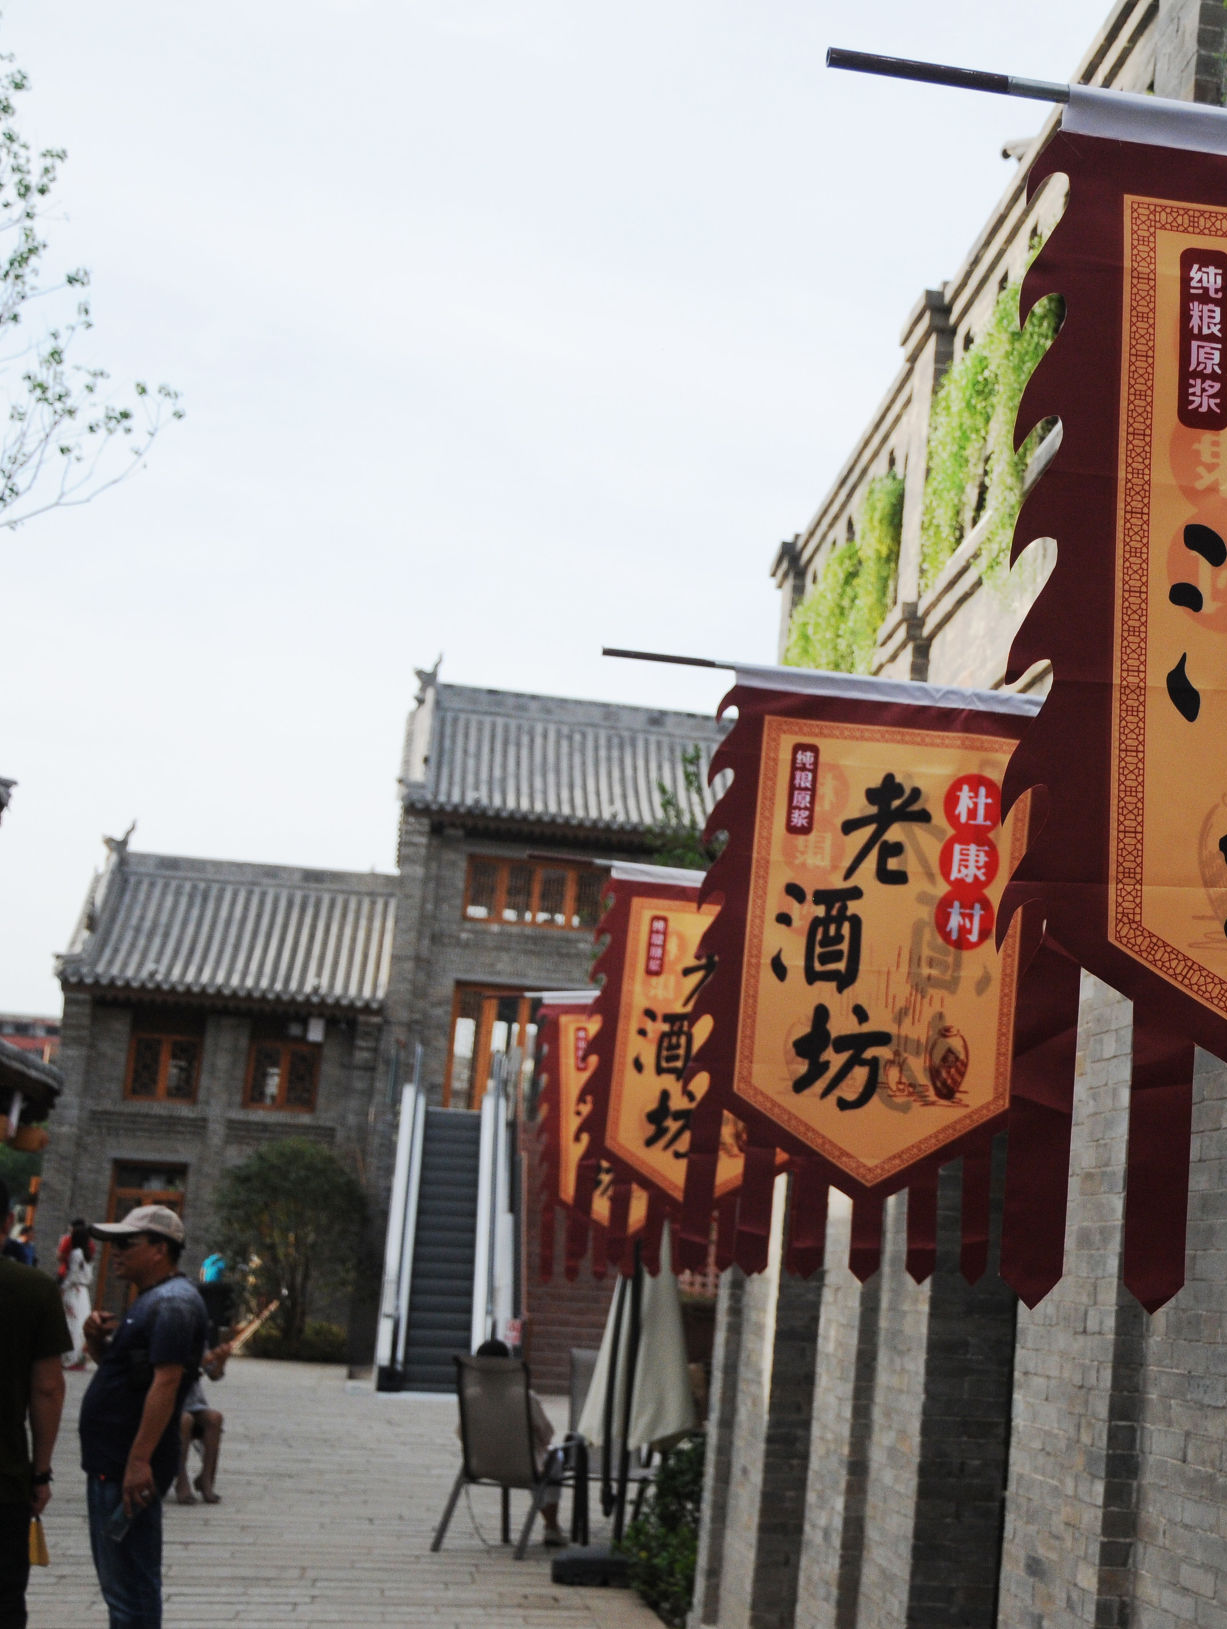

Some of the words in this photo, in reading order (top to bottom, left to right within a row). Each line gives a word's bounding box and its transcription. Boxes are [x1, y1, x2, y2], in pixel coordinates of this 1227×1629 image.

[1188, 264, 1224, 415] 纯粮原浆
[790, 750, 815, 827] 纯粮原浆
[946, 784, 993, 942] 杜康村
[771, 772, 932, 1112] 老酒坊
